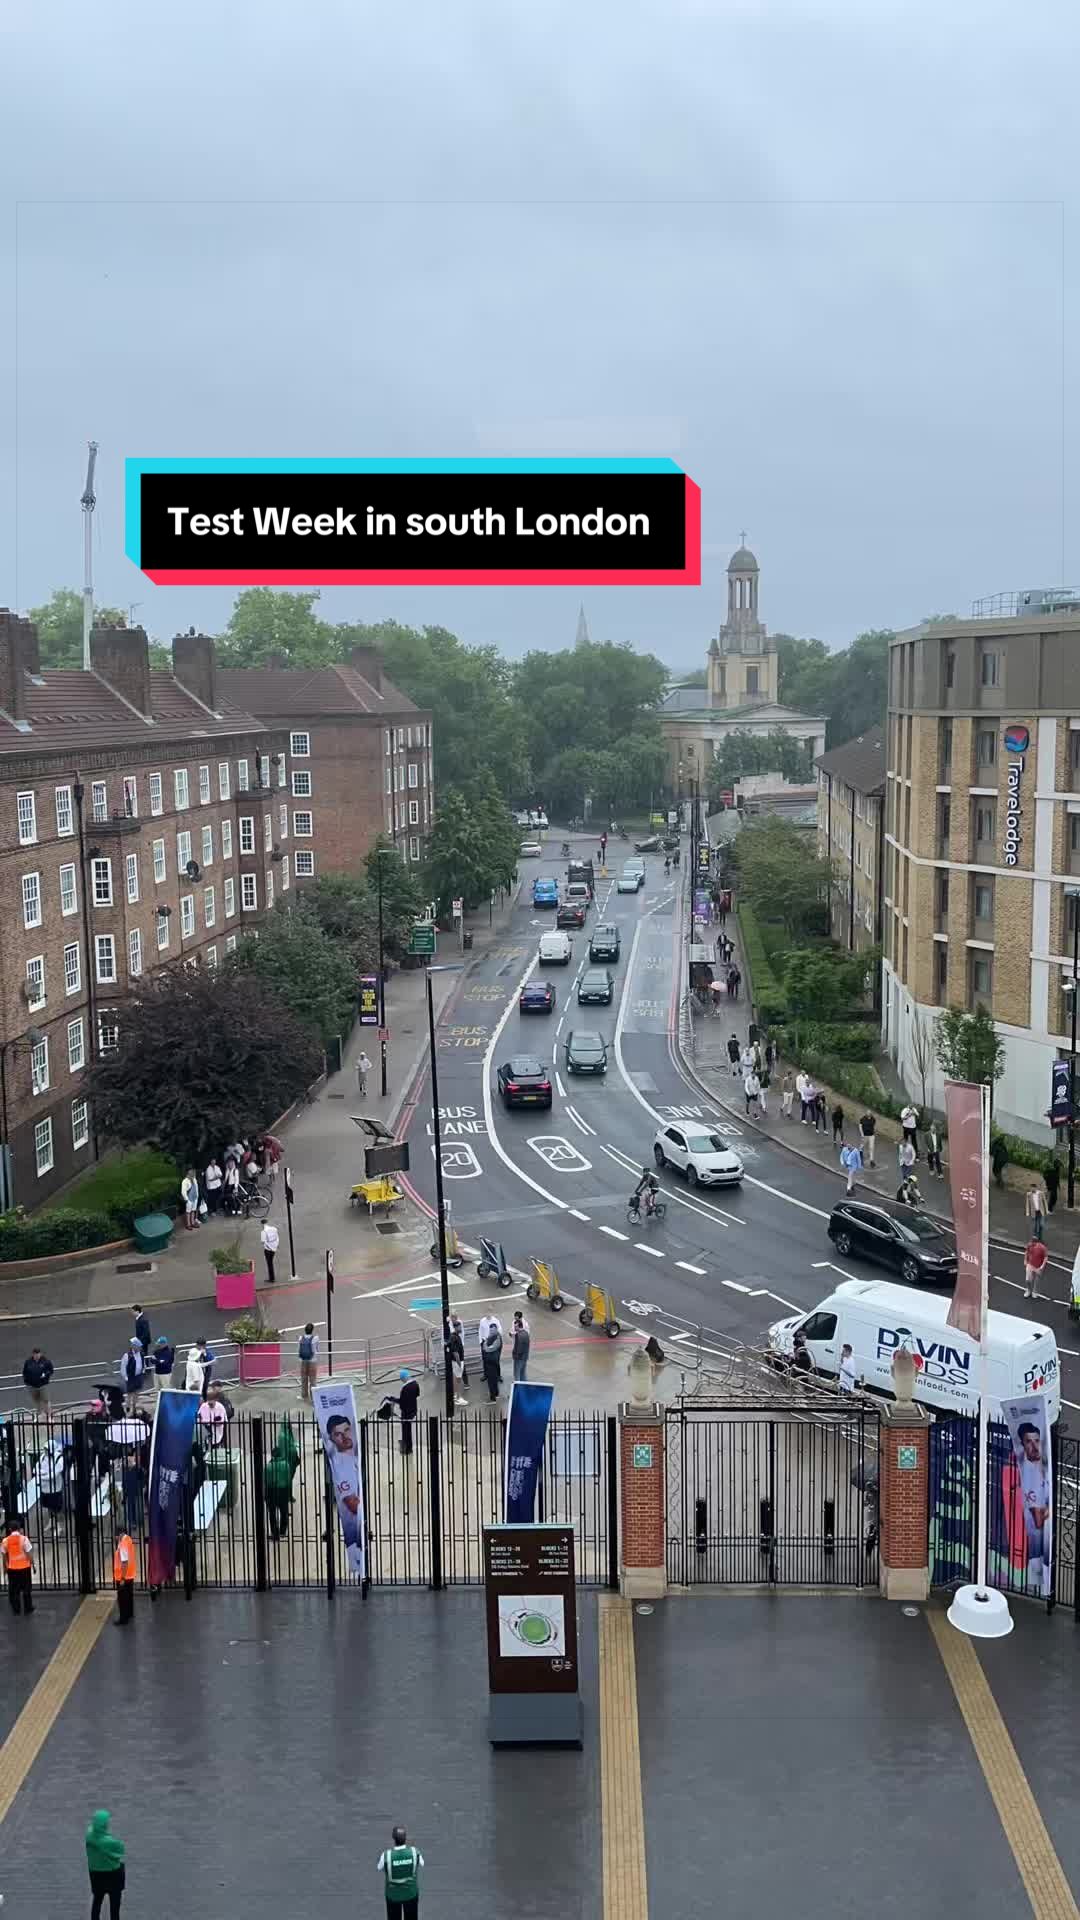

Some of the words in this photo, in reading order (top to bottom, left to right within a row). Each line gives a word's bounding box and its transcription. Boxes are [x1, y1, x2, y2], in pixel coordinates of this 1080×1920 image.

[1003, 757, 1024, 866] Travelodge
[450, 1026, 489, 1036] BUS
[439, 1037, 490, 1047] STOP
[431, 1105, 477, 1120] BUS
[655, 1105, 721, 1118] LANE
[426, 1120, 490, 1136] LANE
[441, 1151, 473, 1167] 20
[540, 1145, 577, 1161] 20
